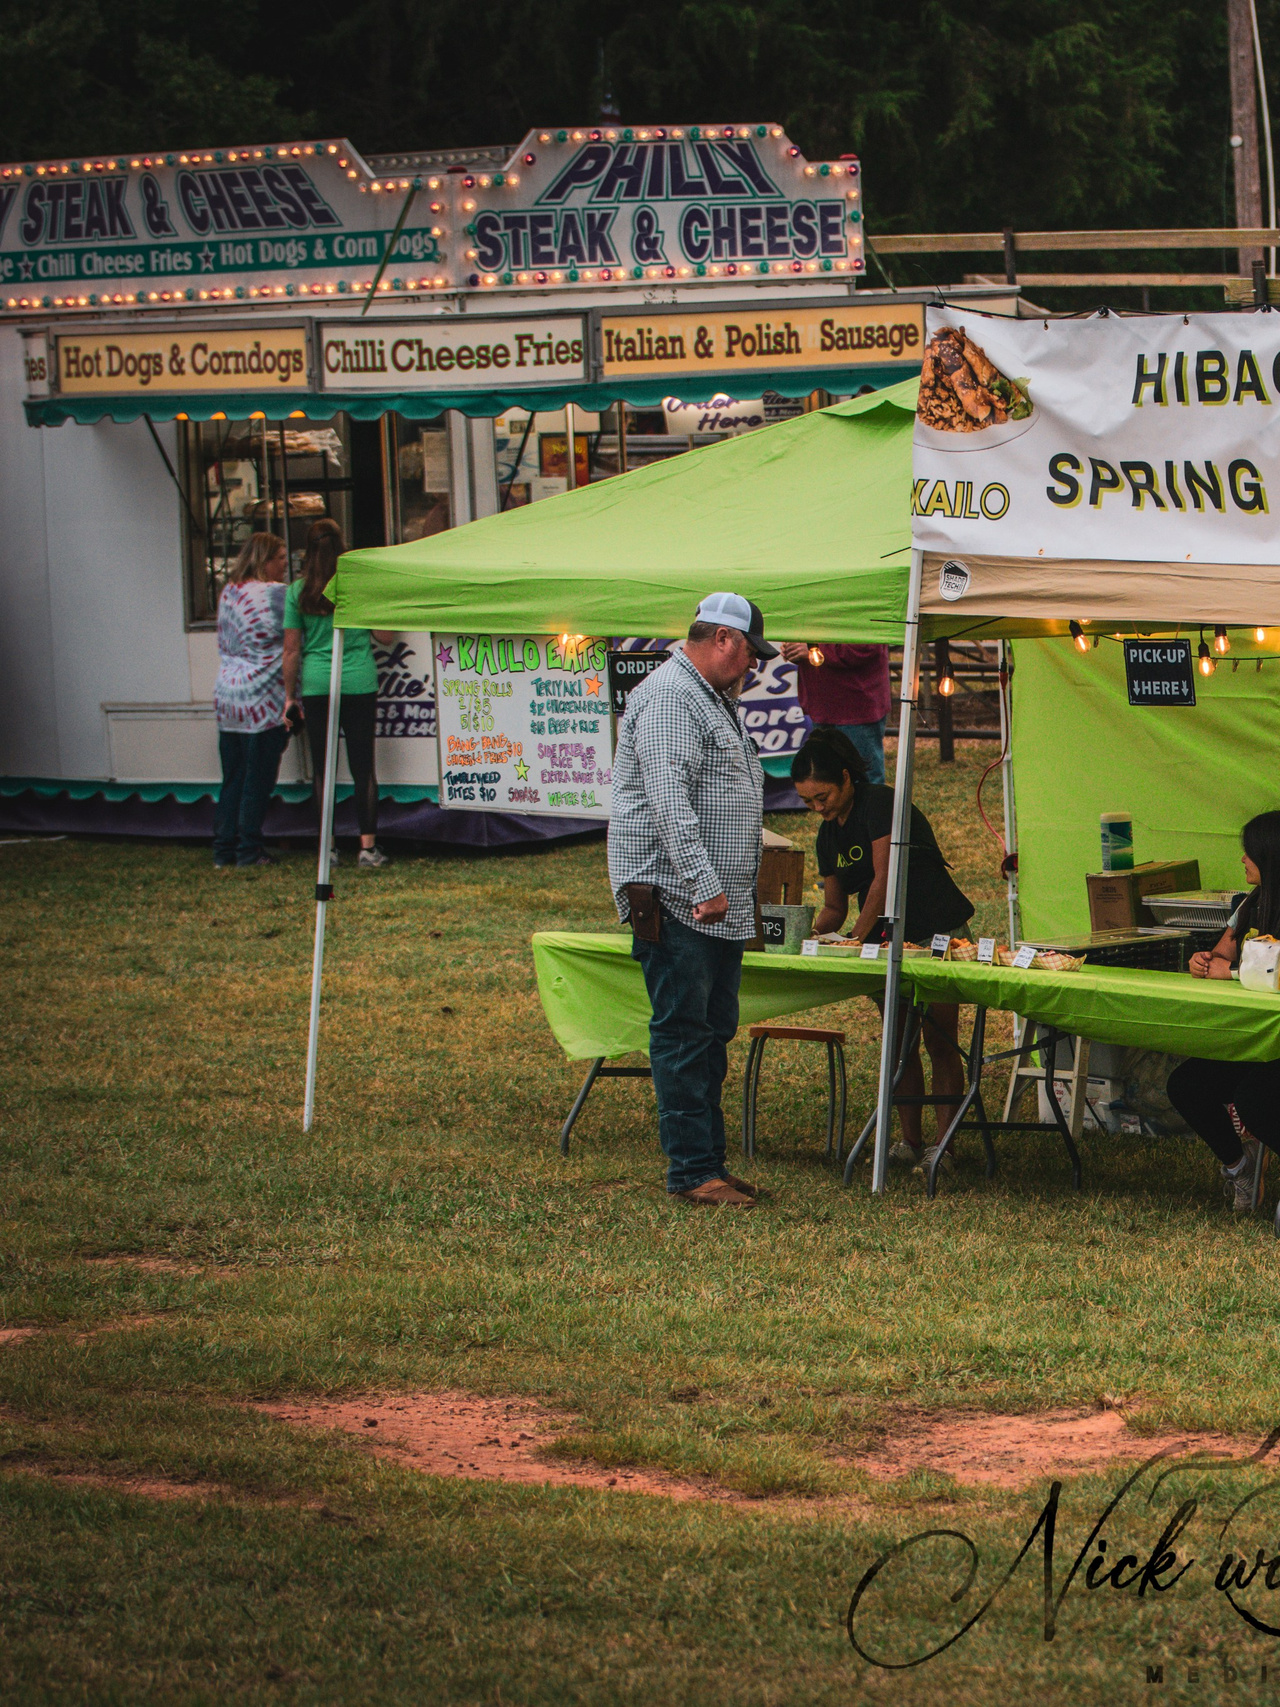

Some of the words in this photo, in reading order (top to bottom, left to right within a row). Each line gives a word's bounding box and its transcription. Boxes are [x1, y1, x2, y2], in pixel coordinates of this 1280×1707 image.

[536, 139, 783, 205] PHILLY
[19, 175, 137, 247] STEAK
[140, 172, 178, 239] &
[176, 163, 342, 236] CHEESE
[474, 206, 621, 273] STEAK
[631, 204, 669, 266] &
[679, 199, 848, 262] CHEESE
[37, 252, 77, 278] Chili
[82, 250, 145, 276] Cheese
[151, 249, 193, 273] Fries
[220, 243, 253, 266] Hot
[259, 239, 307, 268] Dogs
[313, 238, 328, 260] &
[333, 235, 378, 259] Corn
[384, 231, 434, 260] Dogs
[604, 327, 687, 362] Italian
[694, 325, 714, 359] &
[724, 322, 802, 358] Polish
[820, 319, 920, 356] Sausage
[64, 346, 102, 378] Hot
[105, 345, 164, 385] Dogs
[168, 343, 186, 376] &
[191, 341, 304, 383] Corndogs
[325, 339, 388, 373] Chilli
[391, 338, 512, 373] Cheese
[514, 333, 585, 367] Fries
[698, 412, 764, 431] Here
[1046, 452, 1269, 515] SPRING
[910, 479, 1011, 521] KAILO
[457, 634, 541, 676] KAILO
[546, 637, 607, 676] EATS
[1129, 648, 1186, 663] PICK-UP
[442, 678, 481, 698] SPRING
[482, 678, 513, 697] ROLLS
[531, 677, 583, 697] TERIYAKI
[1141, 681, 1180, 695] HERE
[548, 717, 571, 735] BEEF
[579, 719, 600, 734] RICE
[740, 705, 805, 728] ore
[484, 751, 509, 765] FRIES
[507, 741, 523, 757] $10
[537, 743, 558, 759] SIDE
[558, 742, 585, 758] FRIES
[550, 756, 573, 769] RICE
[581, 755, 597, 771] $5
[443, 770, 501, 786] TUMBLEWEED
[541, 769, 571, 784] EXTRA
[572, 770, 595, 783] SAUCE
[596, 768, 612, 786] $1
[447, 786, 476, 801] BITES
[479, 786, 497, 802] $10
[547, 791, 580, 807] WATER
[581, 789, 602, 809] $1
